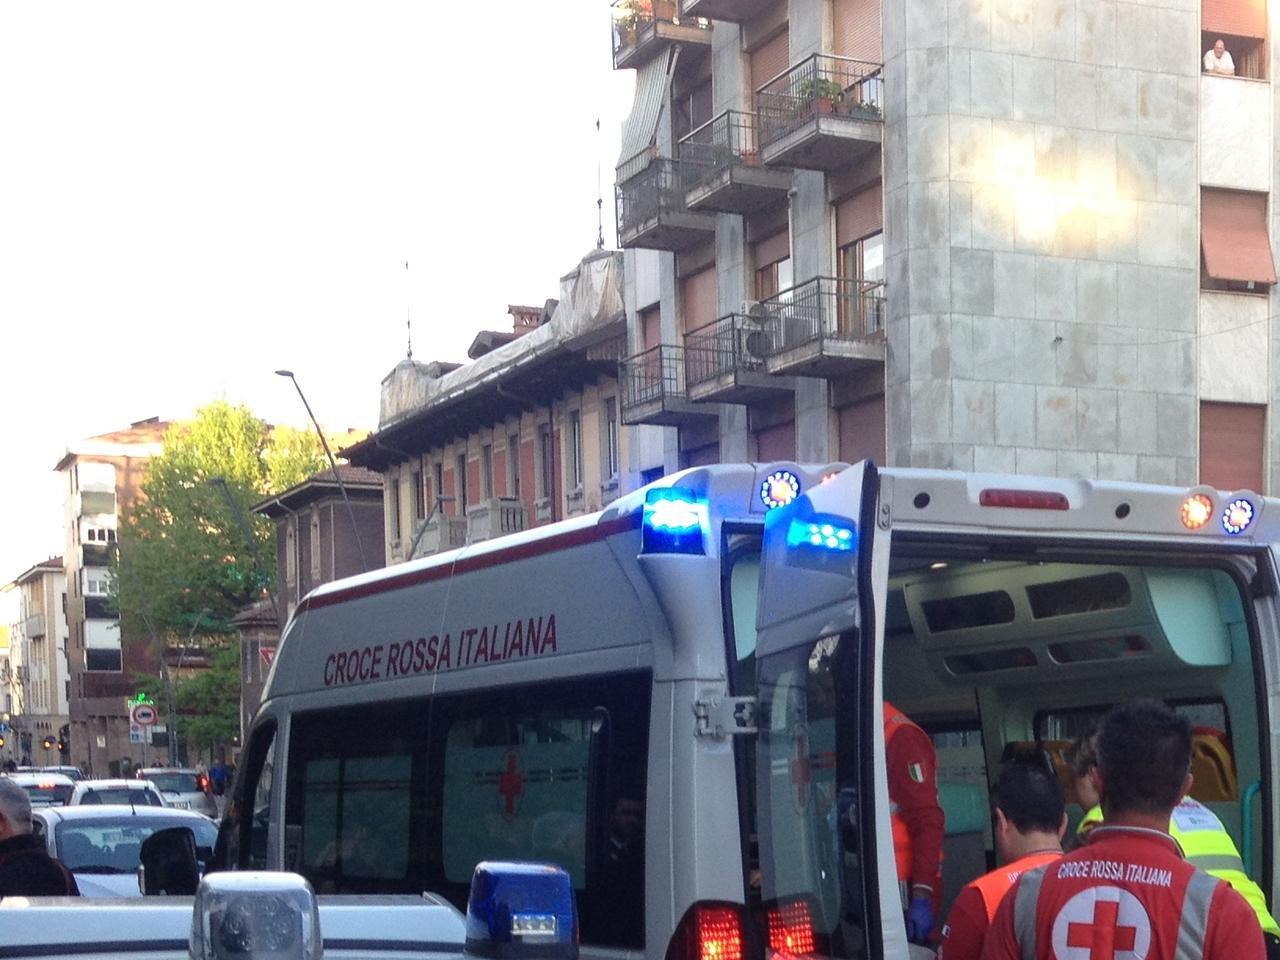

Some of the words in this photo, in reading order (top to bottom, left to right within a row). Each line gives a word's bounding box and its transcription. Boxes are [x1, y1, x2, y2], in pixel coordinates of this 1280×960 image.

[323, 645, 384, 686] CROCE
[386, 633, 451, 678] ROSSA
[456, 613, 557, 667] ITALIANA
[1057, 860, 1092, 880] CROCE
[1090, 860, 1124, 881] ROSSA
[1125, 863, 1173, 888] ITALIANA
